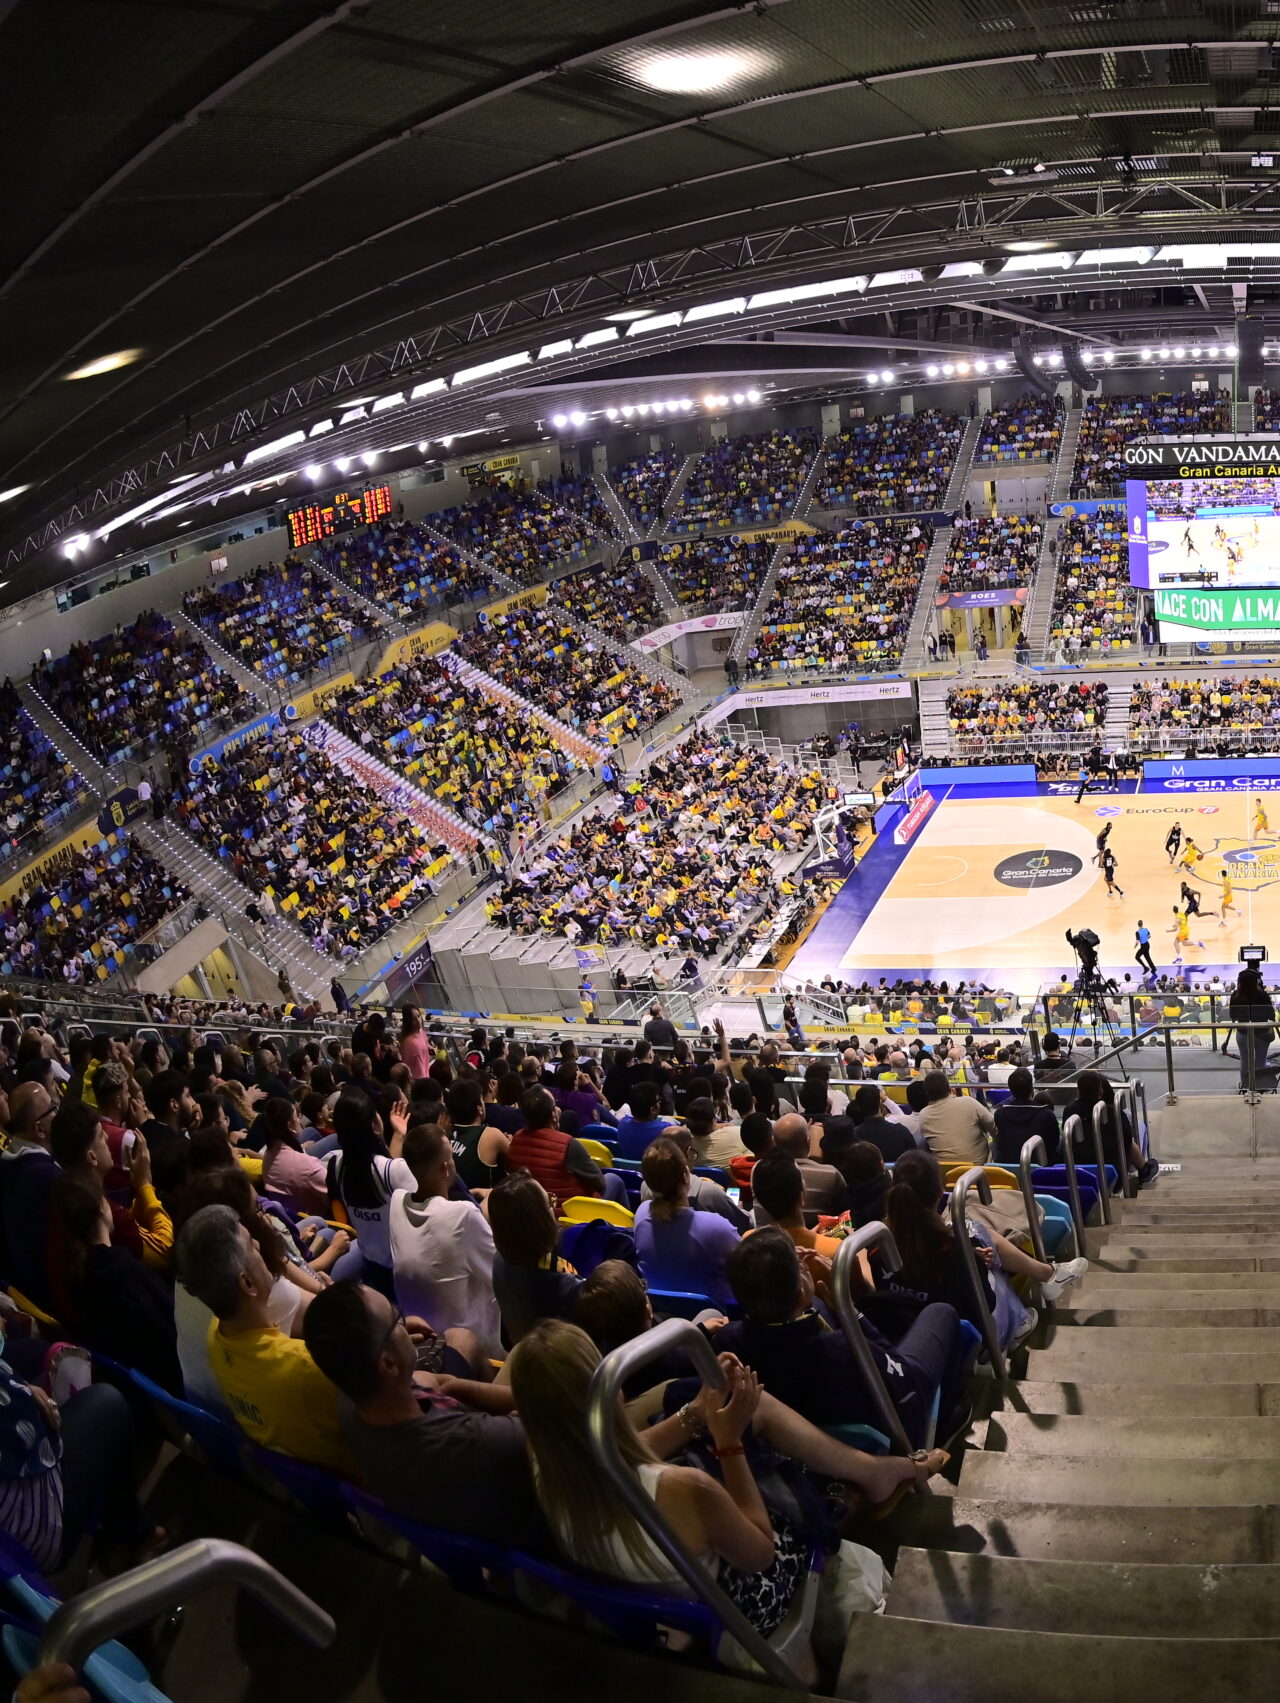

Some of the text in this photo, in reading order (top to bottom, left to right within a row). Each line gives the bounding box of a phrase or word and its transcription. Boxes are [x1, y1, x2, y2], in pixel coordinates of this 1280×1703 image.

[1125, 447, 1163, 464] GÓN
[1179, 466, 1211, 478] Gran
[1214, 465, 1264, 477] Canaria
[1155, 590, 1188, 618] NACE
[1191, 596, 1224, 622] CON
[809, 690, 831, 699] Hertz
[879, 686, 901, 695] Hertz
[744, 695, 765, 704] Hertz
[1171, 764, 1185, 776] M
[1163, 778, 1225, 789] Gran
[1029, 867, 1073, 876] Canaria
[1228, 862, 1266, 871] GRAN
